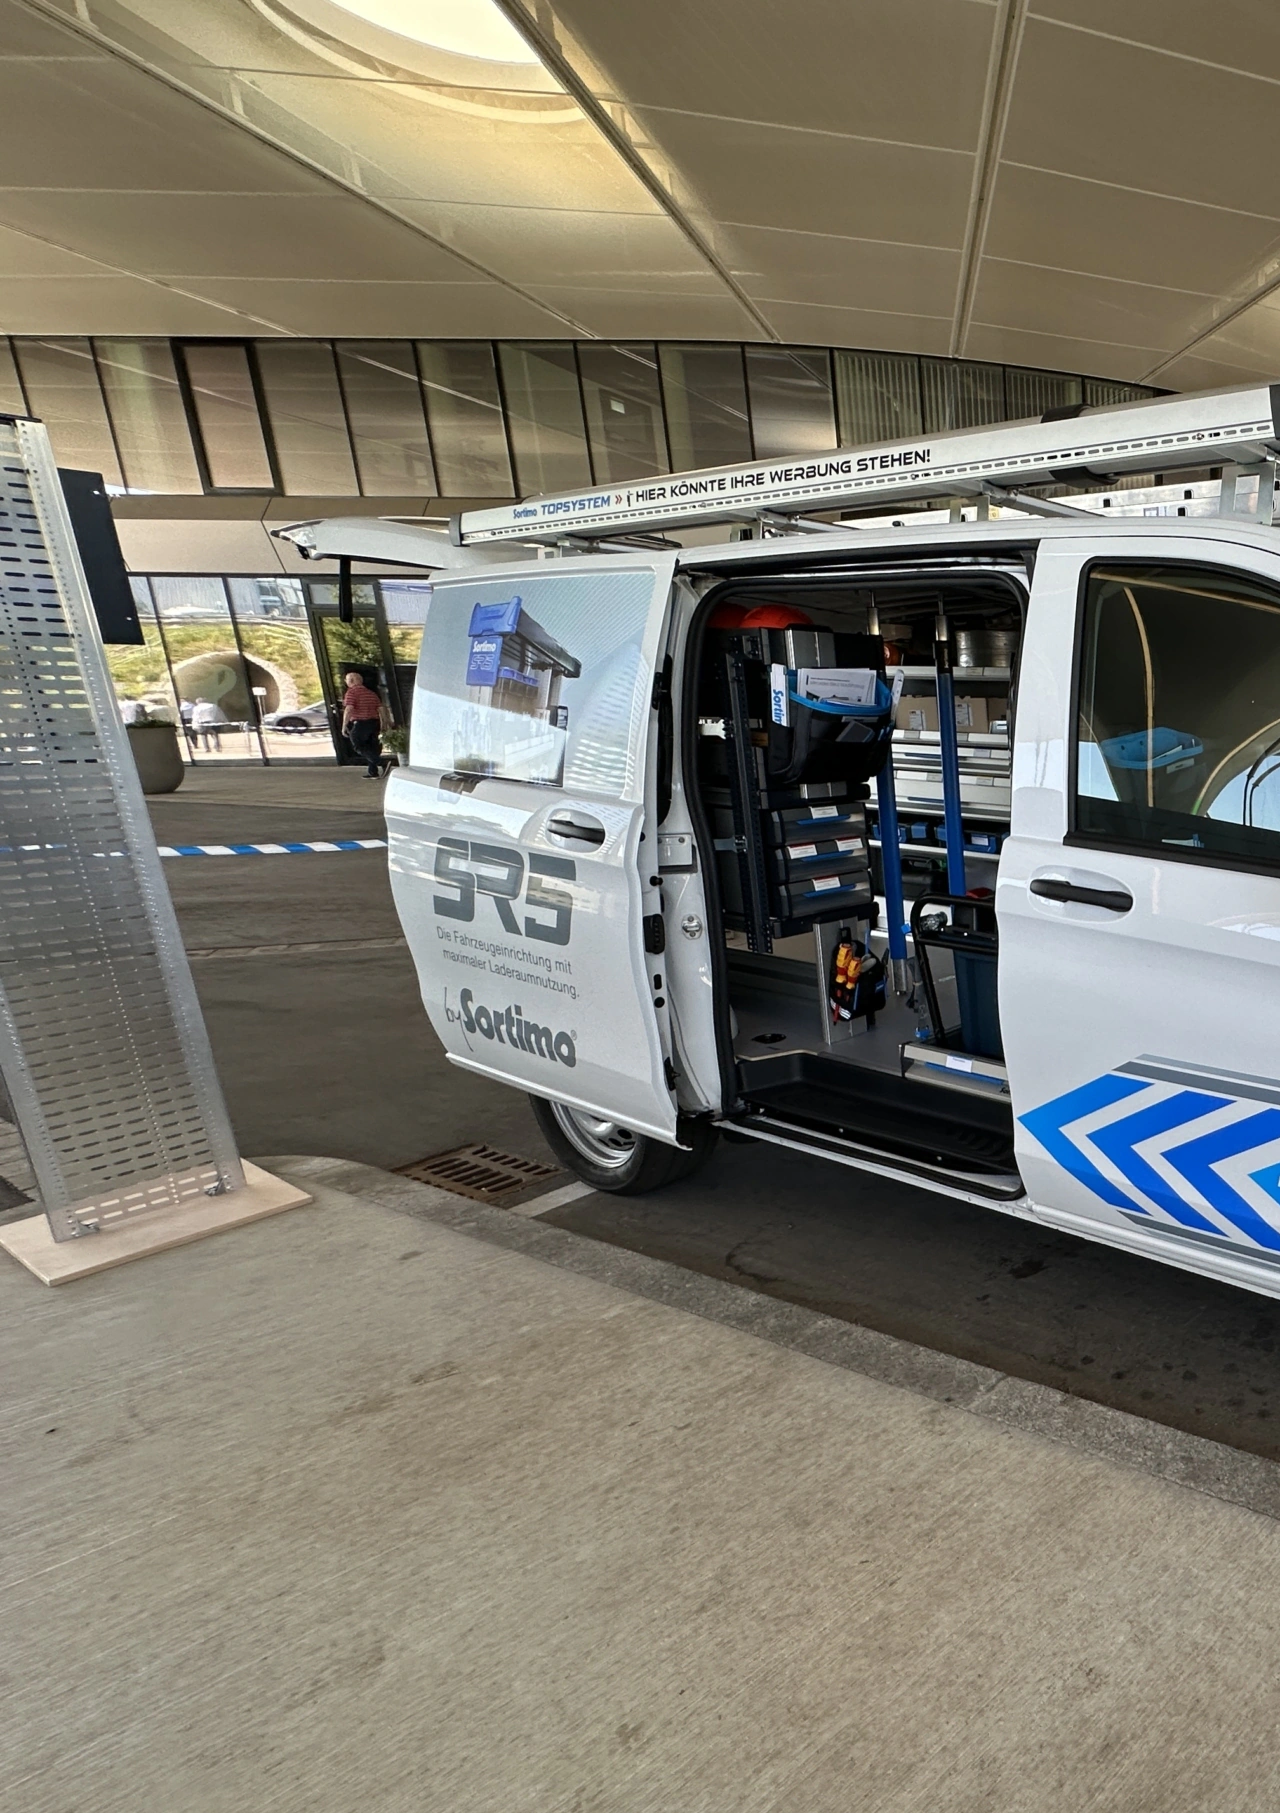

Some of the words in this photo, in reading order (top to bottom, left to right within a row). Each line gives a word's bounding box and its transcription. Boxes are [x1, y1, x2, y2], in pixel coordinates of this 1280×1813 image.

[636, 487, 667, 502] HIER
[670, 477, 726, 497] KÖNNTE
[730, 472, 765, 490] IHRE
[769, 460, 851, 483] WERBUNG
[856, 448, 931, 472] STEHEN!
[541, 495, 611, 516] TOPSYSTEM
[437, 925, 452, 941] Die
[453, 930, 552, 973] Fahrzeugeinrichtung
[555, 961, 573, 975] mit
[442, 949, 487, 972] maximaler
[489, 960, 580, 1000] Laderaumnutzung.
[444, 987, 474, 1052] by
